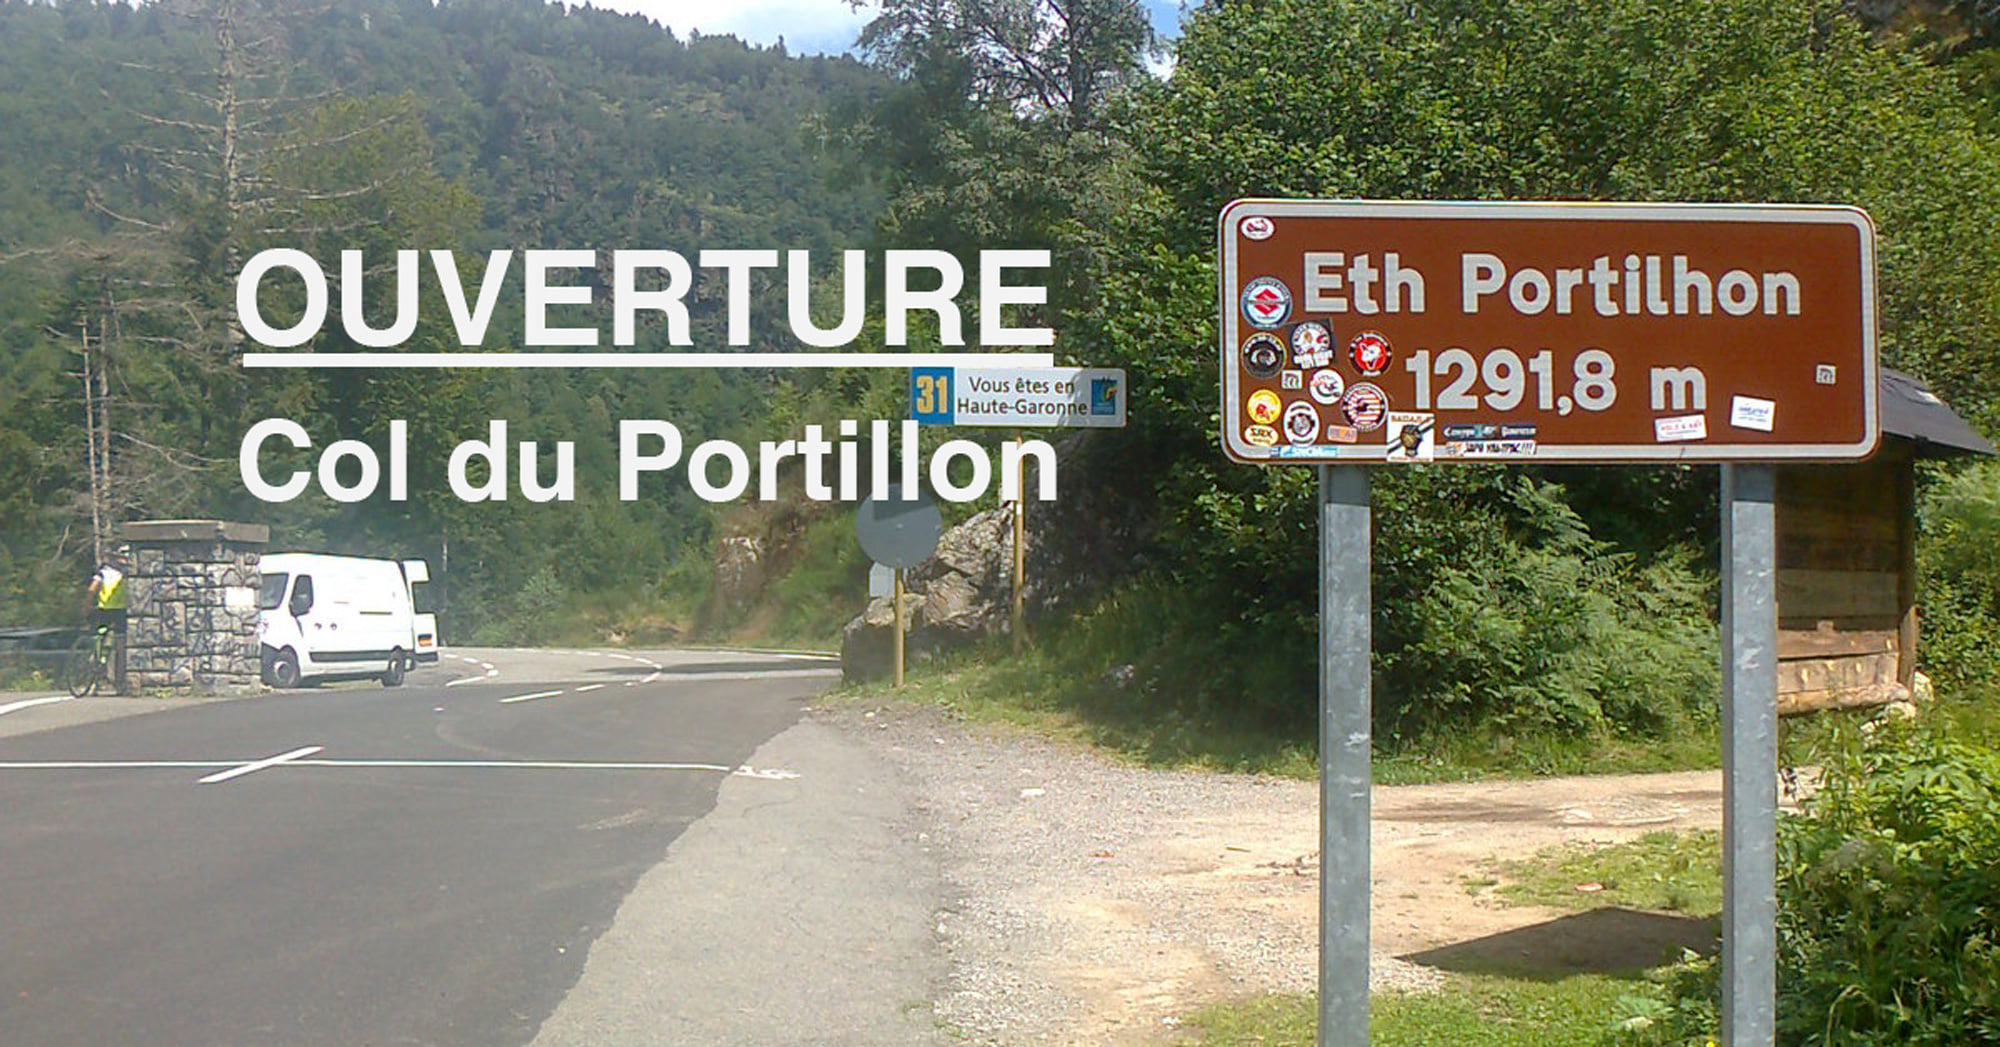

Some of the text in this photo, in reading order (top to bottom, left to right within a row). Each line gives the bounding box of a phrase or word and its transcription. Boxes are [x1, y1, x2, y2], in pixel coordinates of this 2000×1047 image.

[1303, 251, 1801, 317] Eth Portilhon
[916, 375, 948, 414] 31
[969, 376, 1075, 394] Vous êtes en
[1405, 347, 1708, 416] 1291,8 m
[957, 398, 1088, 415] Haute-Garonne
